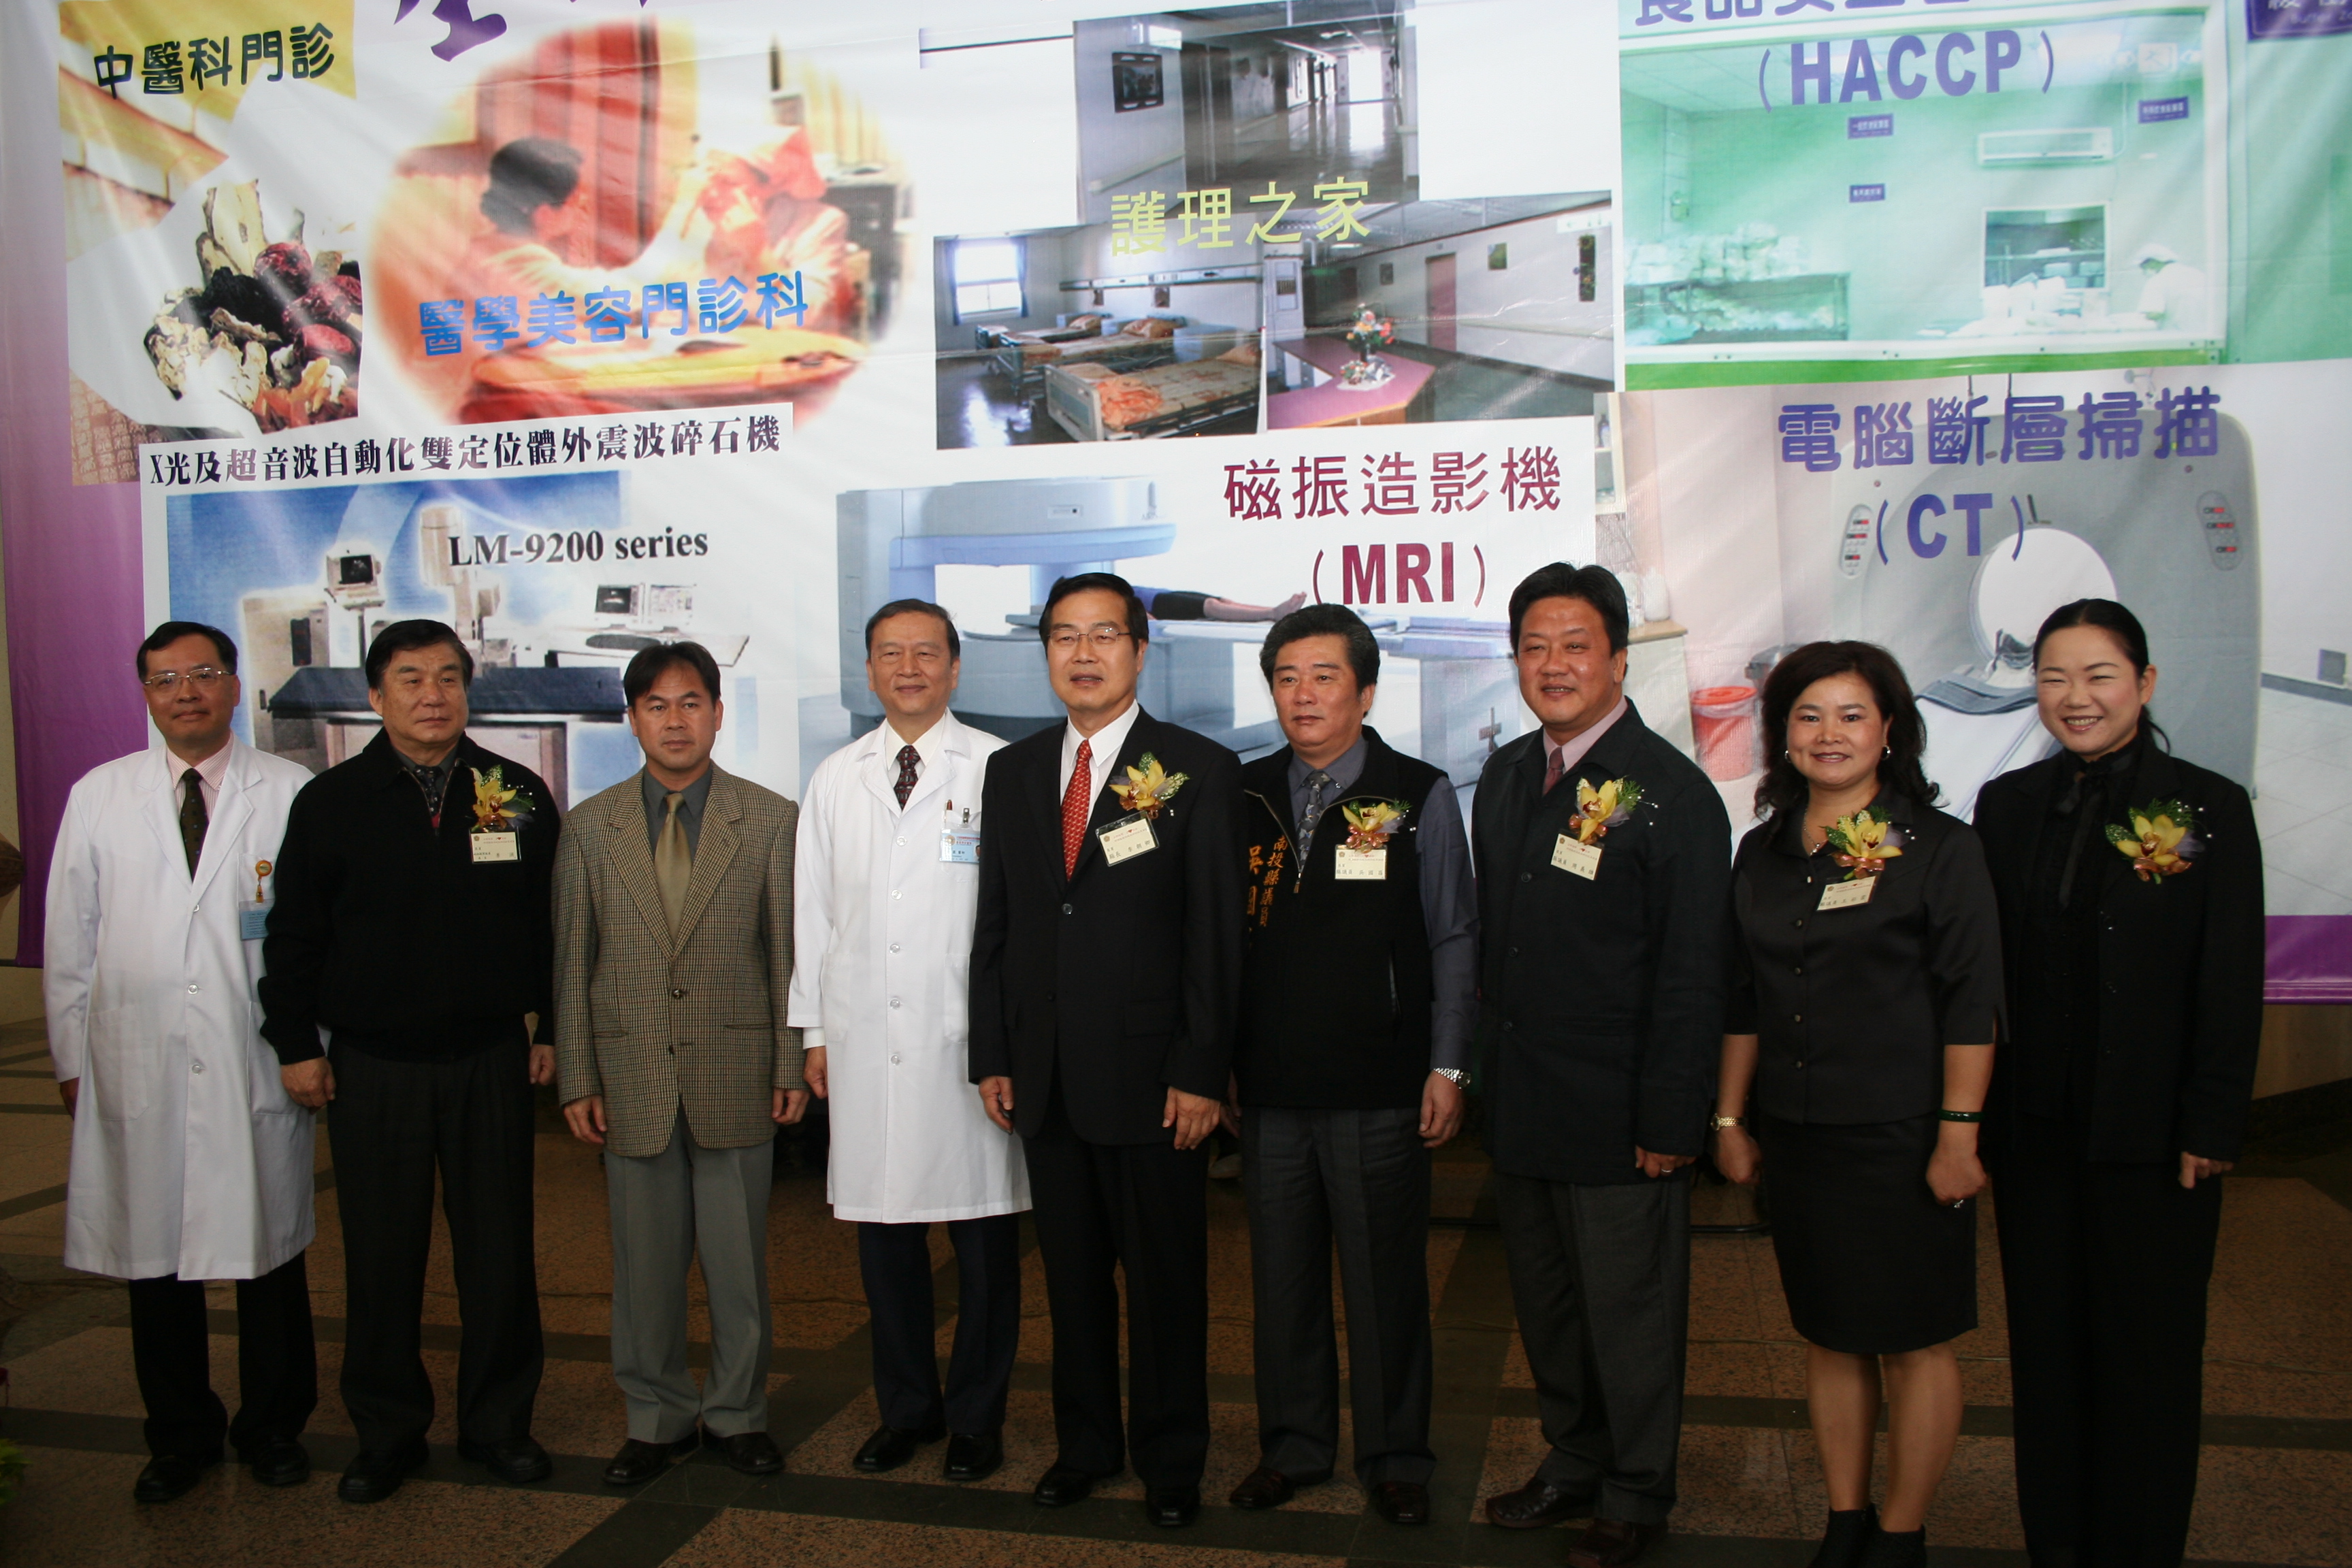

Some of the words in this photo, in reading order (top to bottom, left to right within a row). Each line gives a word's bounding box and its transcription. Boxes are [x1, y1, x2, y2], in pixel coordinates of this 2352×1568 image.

[94, 22, 334, 99] 中醫科門診
[1111, 176, 1370, 256] 護理之家
[419, 270, 808, 357] 醫學美容門診科
[150, 415, 781, 486] X光及超音波自動化雙定位體外震波碎石機
[1778, 386, 2220, 472] 電腦斷層掃描
[1224, 446, 1561, 521] 磁振造影機
[448, 530, 604, 566] LM-9200
[615, 527, 708, 559] series
[1259, 834, 1288, 927] 南投縣議員
